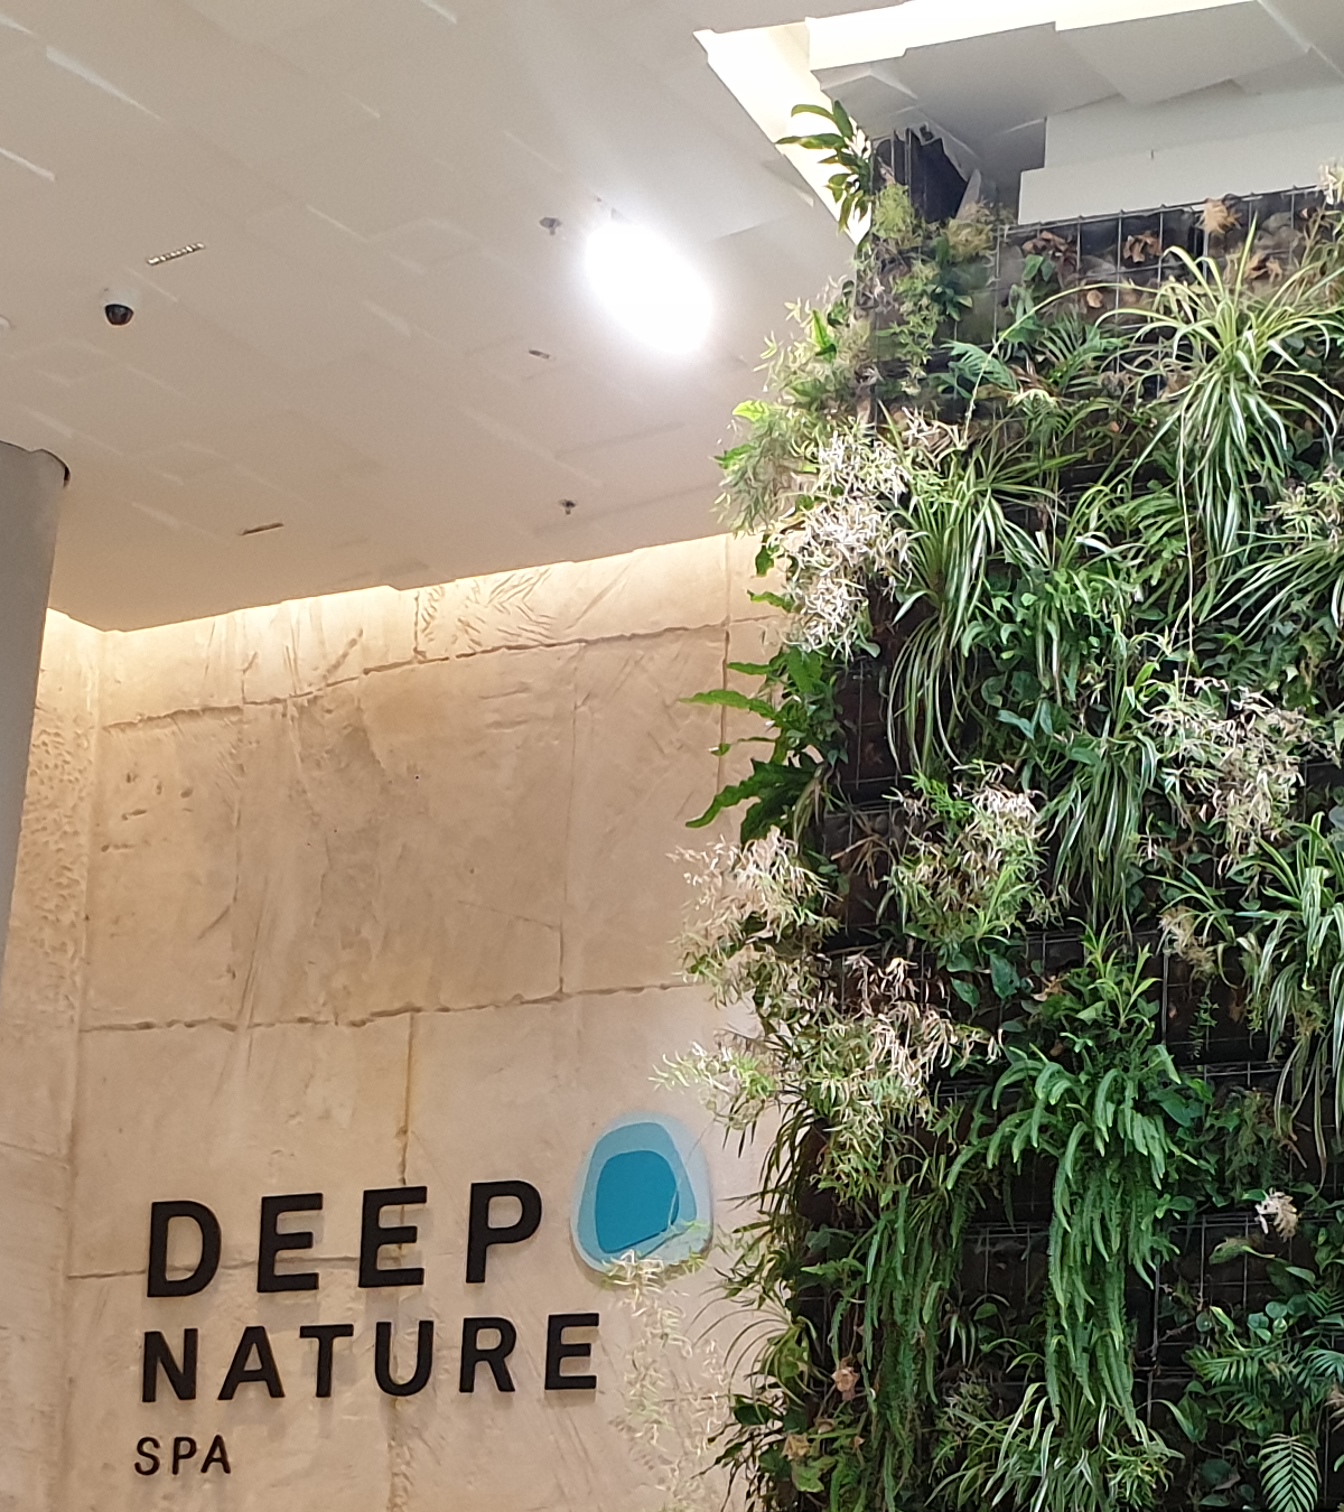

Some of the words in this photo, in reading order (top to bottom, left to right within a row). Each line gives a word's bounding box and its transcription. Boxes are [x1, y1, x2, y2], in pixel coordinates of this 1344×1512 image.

[147, 1180, 543, 1298] DEEP
[142, 1313, 600, 1402] NATURE
[134, 1434, 232, 1475] SPA
